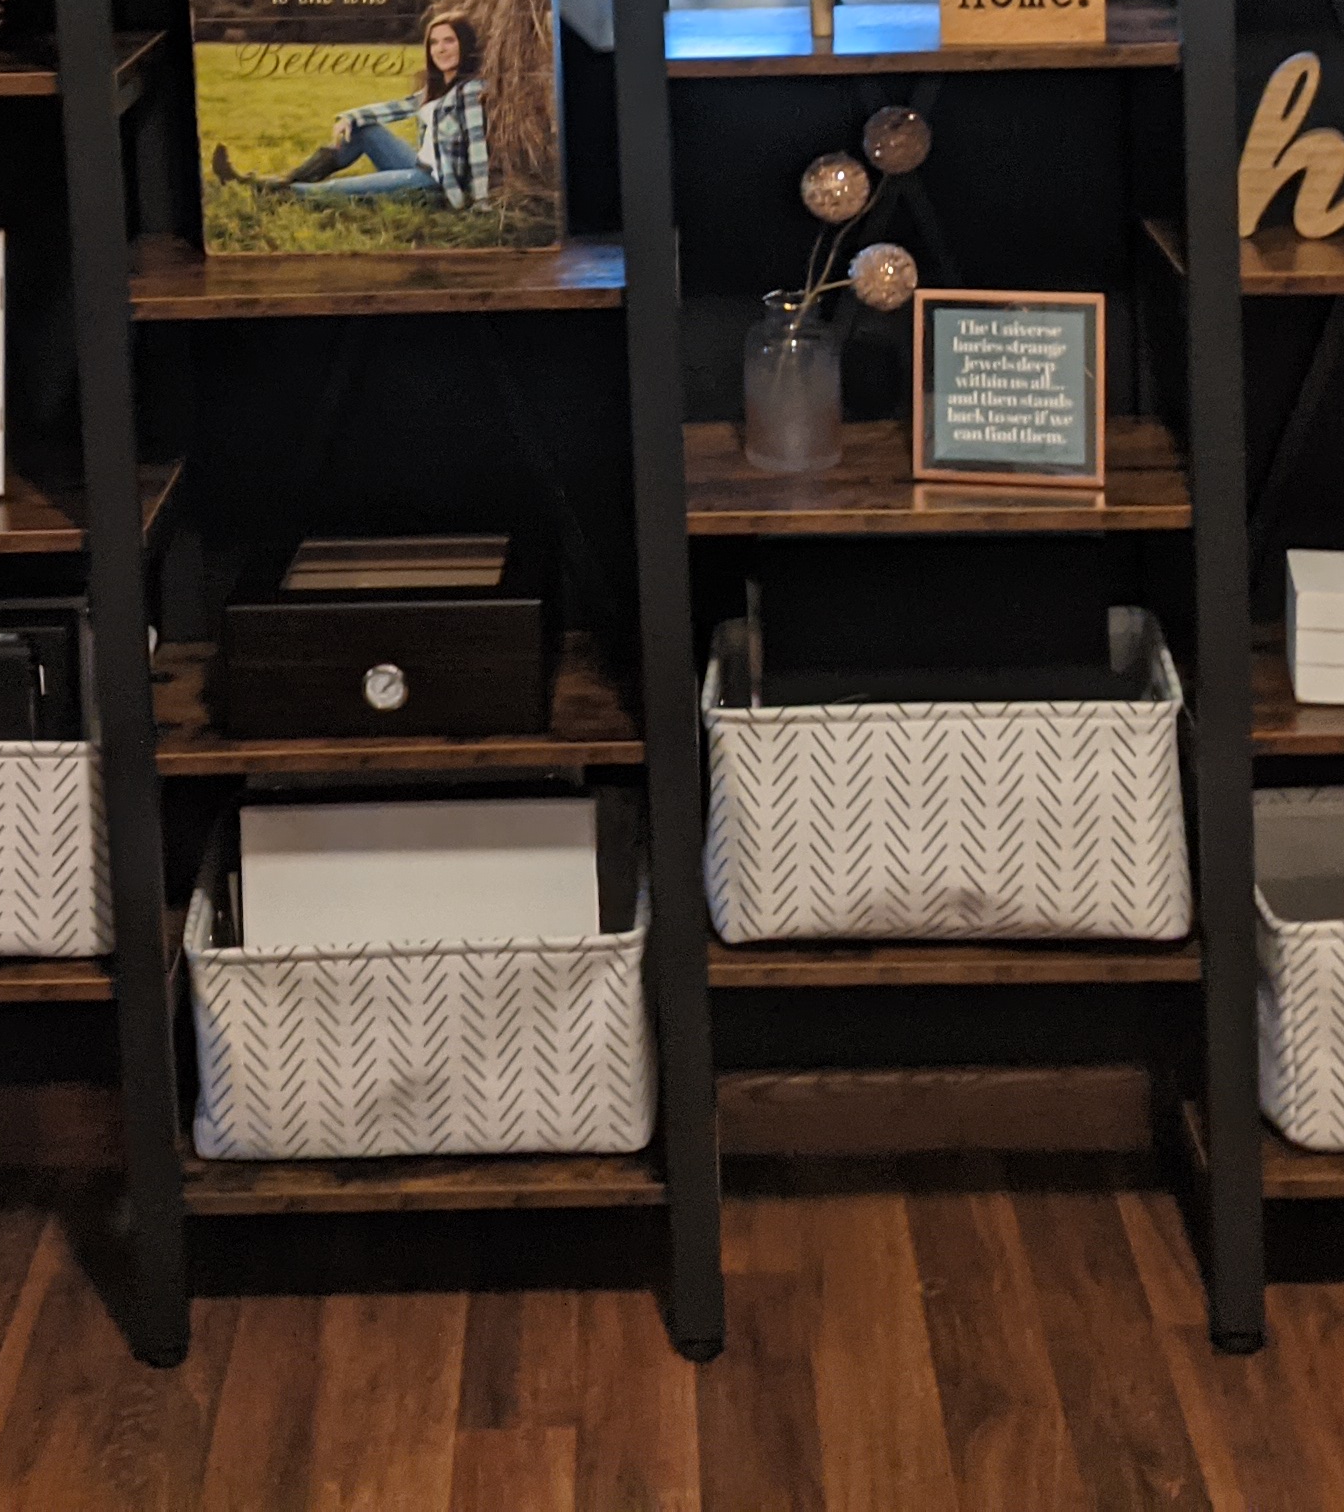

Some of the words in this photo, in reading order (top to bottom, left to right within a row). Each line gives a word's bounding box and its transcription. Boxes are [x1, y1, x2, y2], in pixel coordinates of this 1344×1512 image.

[236, 40, 411, 78] Believes
[958, 318, 989, 336] The
[991, 320, 1063, 338] Universe
[953, 336, 1004, 354] buries
[1005, 338, 1067, 358] strange
[961, 355, 1015, 374] jewels
[1016, 356, 1056, 375] deep
[954, 373, 1009, 391] within
[1009, 377, 1029, 390] us
[947, 390, 978, 407] and
[980, 390, 1017, 407] then
[1018, 392, 1073, 409] stands
[947, 407, 985, 424] back
[987, 409, 1003, 424] to
[1004, 411, 1032, 425] see
[1033, 409, 1048, 426] if
[1049, 413, 1074, 427] we
[953, 428, 982, 442] can
[984, 426, 1018, 443] find
